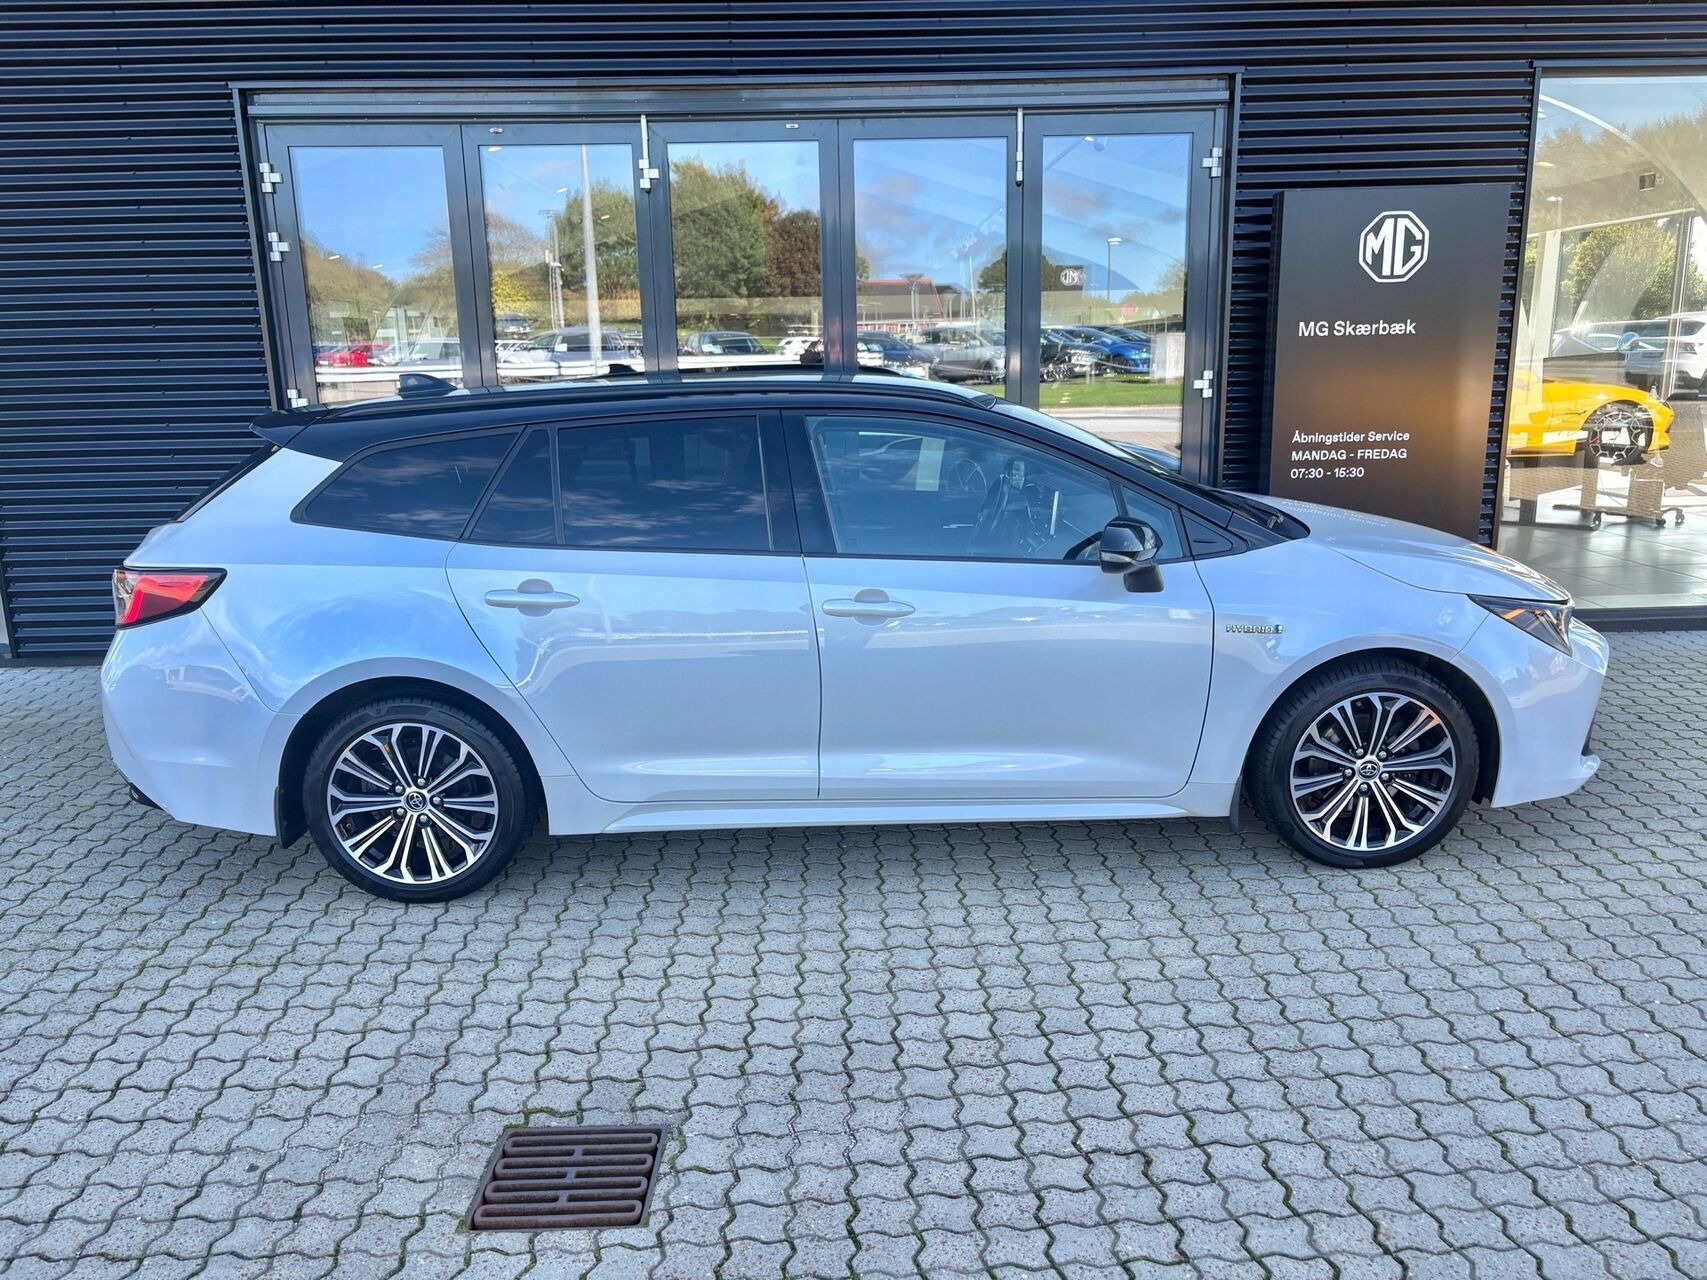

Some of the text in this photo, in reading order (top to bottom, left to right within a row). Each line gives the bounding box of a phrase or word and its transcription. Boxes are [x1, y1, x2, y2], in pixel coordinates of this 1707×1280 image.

[1363, 215, 1425, 279] MG
[1298, 318, 1417, 337] MG Skærbæk
[1291, 429, 1410, 445] Åbningstider Service
[1291, 449, 1347, 461] MANDAG
[1357, 448, 1408, 460] FREDAG
[1290, 467, 1324, 479] 07:30
[1333, 466, 1365, 478] 15:30
[1226, 624, 1274, 634] HYBRID
